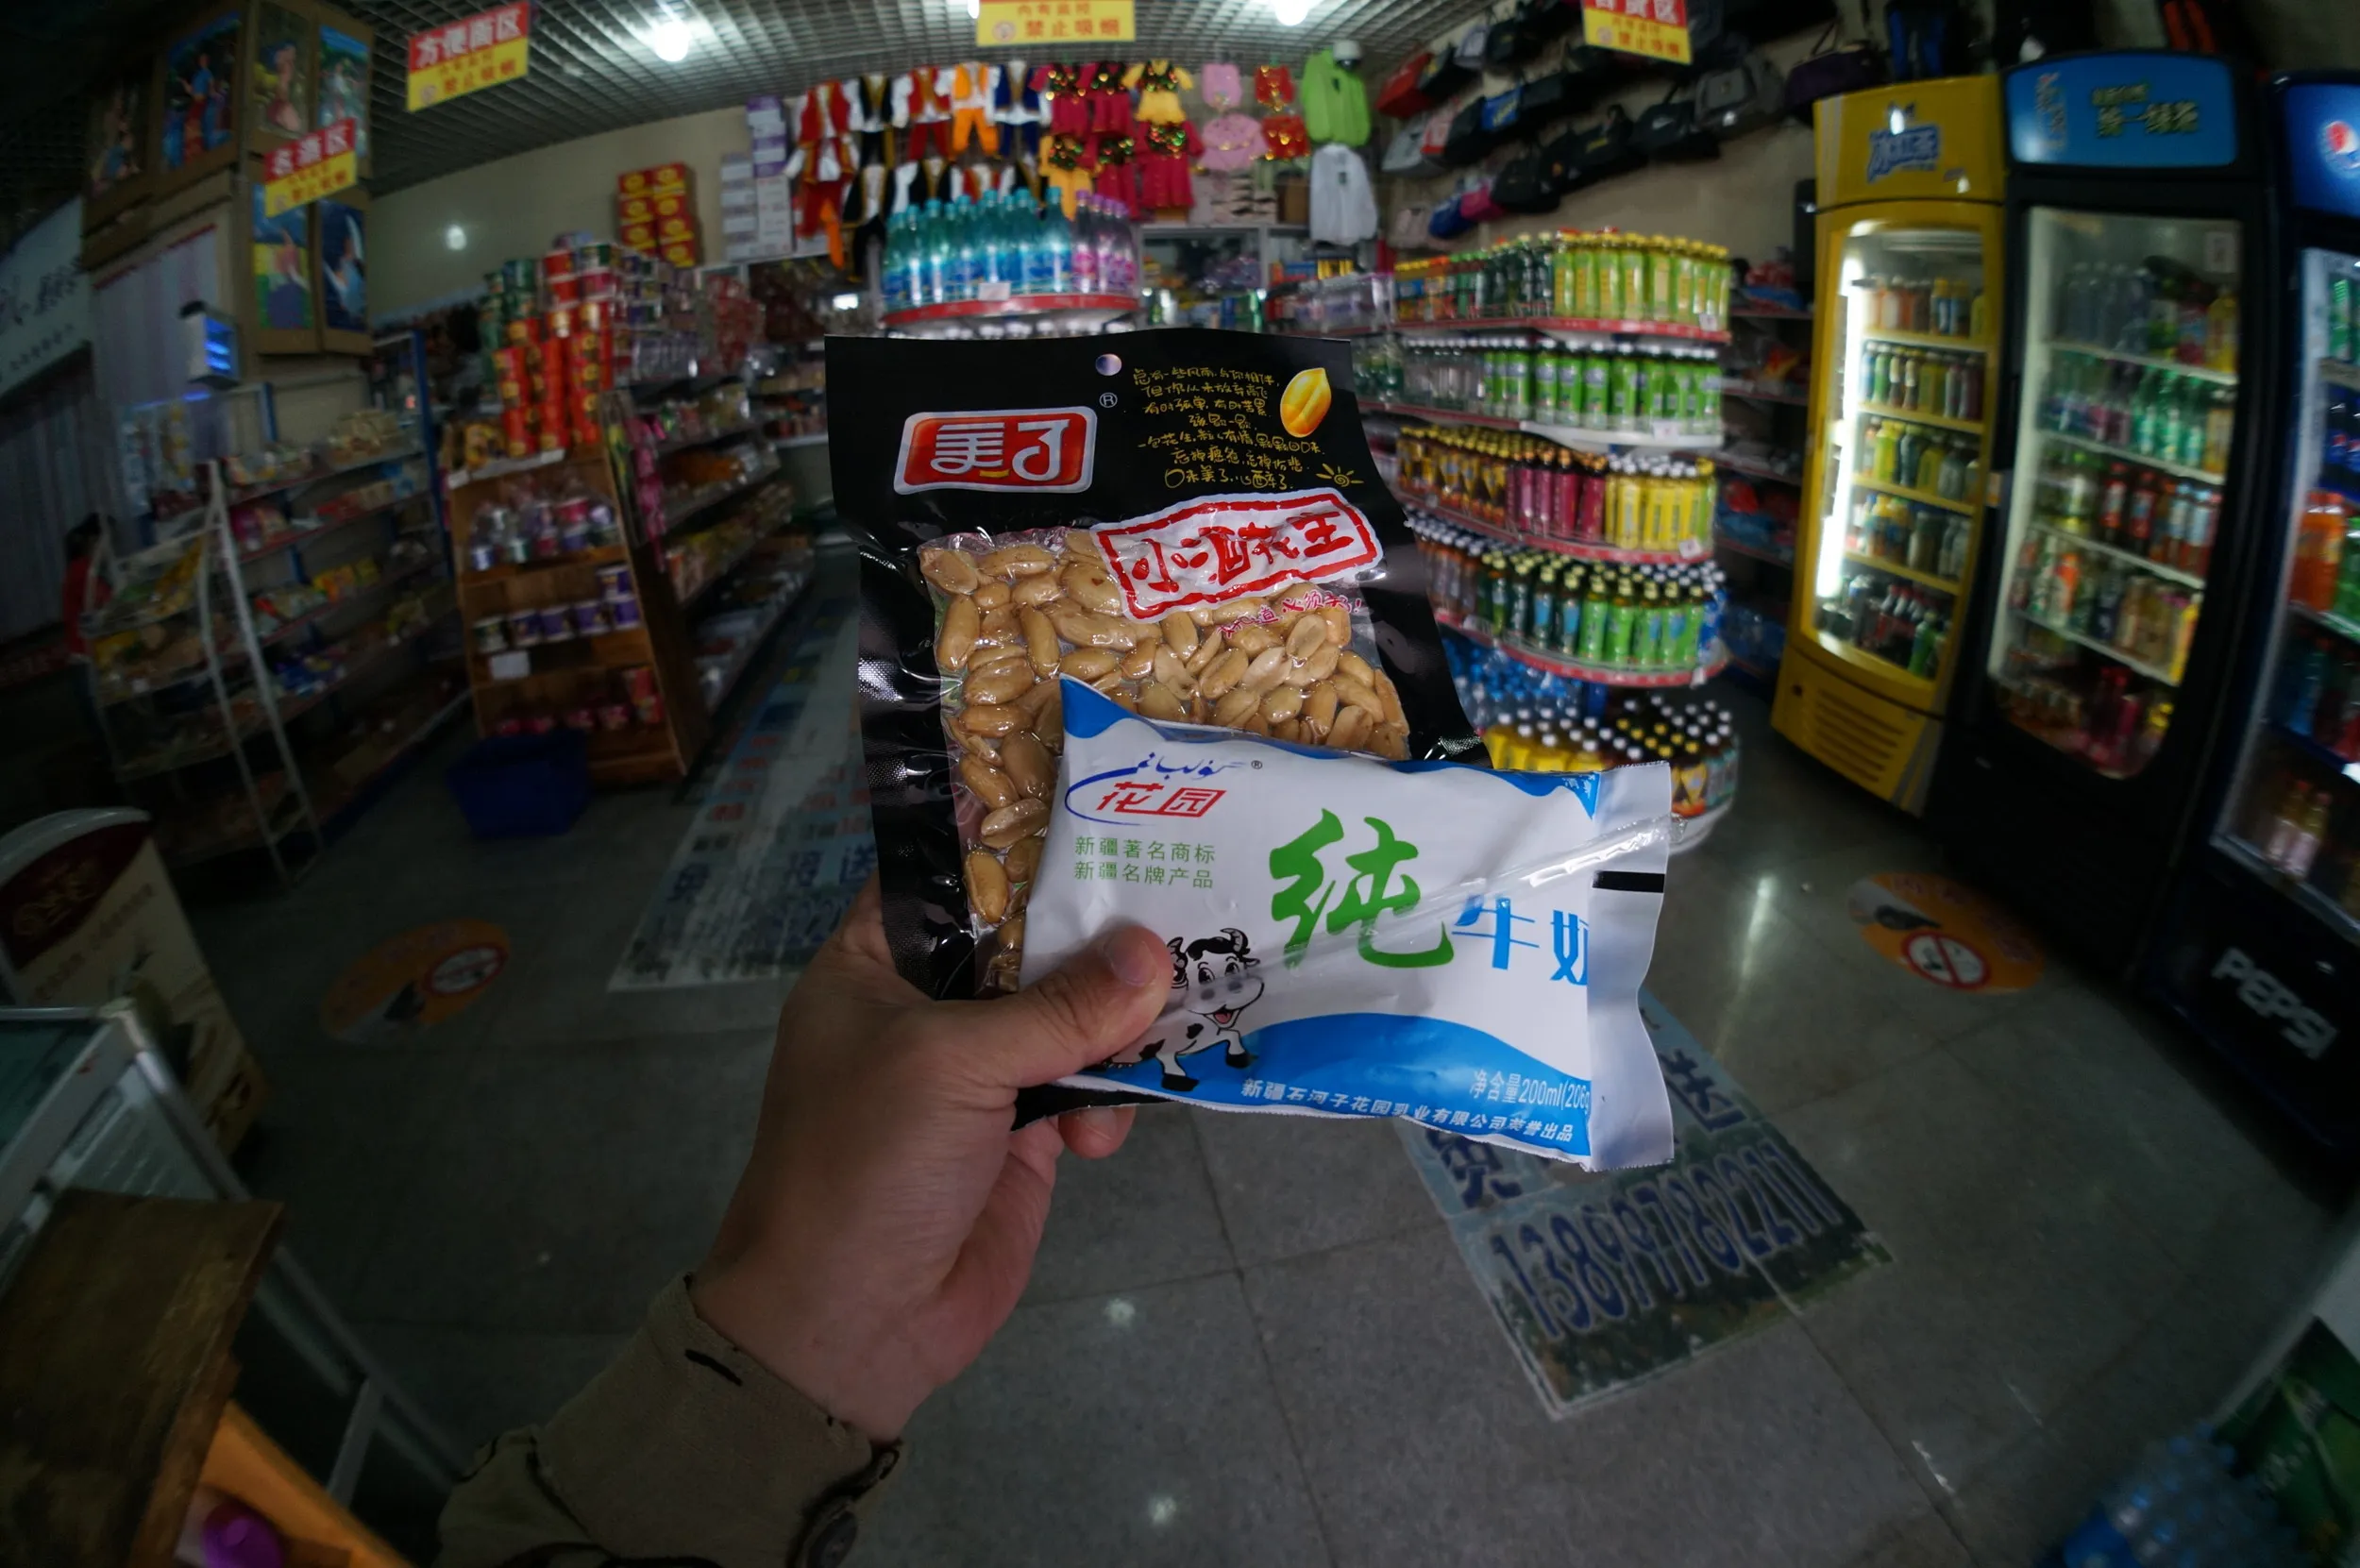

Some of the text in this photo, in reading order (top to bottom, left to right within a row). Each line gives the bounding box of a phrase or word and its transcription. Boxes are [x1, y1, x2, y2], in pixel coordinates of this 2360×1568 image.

[1096, 782, 1227, 818] 花园
[1074, 835, 1216, 865] 新疆著名商标
[1073, 860, 1214, 889] 新疆名牌产品
[2212, 947, 2339, 1060] PEPSI
[1240, 1077, 1574, 1143] 新疆石河子花园乳业有限公司荣誉出品
